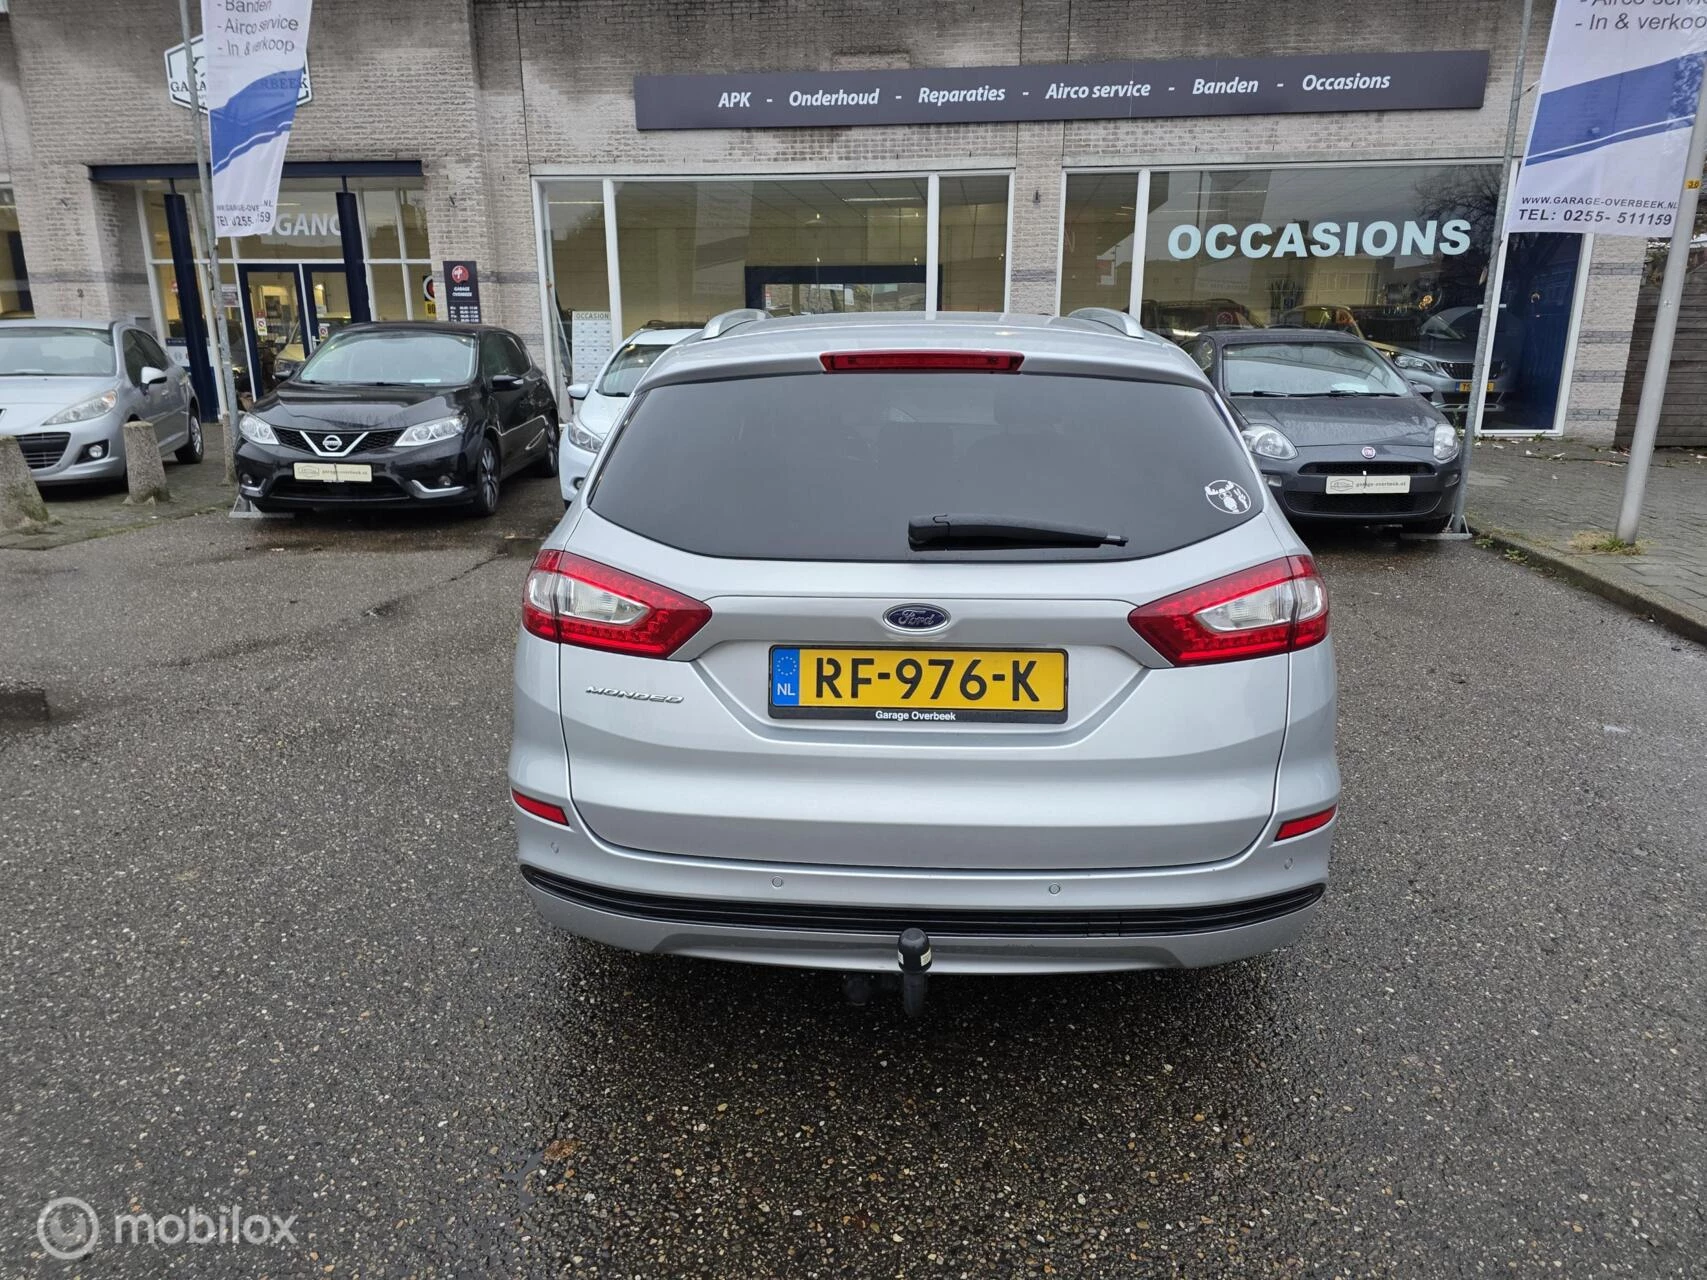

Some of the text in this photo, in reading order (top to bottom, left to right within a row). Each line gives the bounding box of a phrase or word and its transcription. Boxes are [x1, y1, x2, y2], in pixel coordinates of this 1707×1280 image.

[1589, 13, 1608, 30] In
[1614, 12, 1630, 30] &
[226, 39, 239, 56] In
[718, 91, 751, 108] APK
[788, 88, 880, 107] Onderhoud
[918, 85, 1006, 107] Reparaties
[1045, 82, 1090, 100] Airco
[1091, 79, 1151, 98] service
[1192, 77, 1259, 95] Banden
[1302, 72, 1391, 92] Occasions
[1521, 196, 1678, 210] WWW.GARAGE-OVERBEEK.NL
[1518, 208, 1672, 226] TEL: 0255- 511159
[1167, 219, 1472, 260] OCCASIONS
[897, 608, 935, 626] Ford
[815, 656, 1040, 702] RF-976-K
[585, 685, 686, 704] MONDEO
[777, 682, 796, 696] NL
[875, 709, 957, 722] Garage Overbeek
